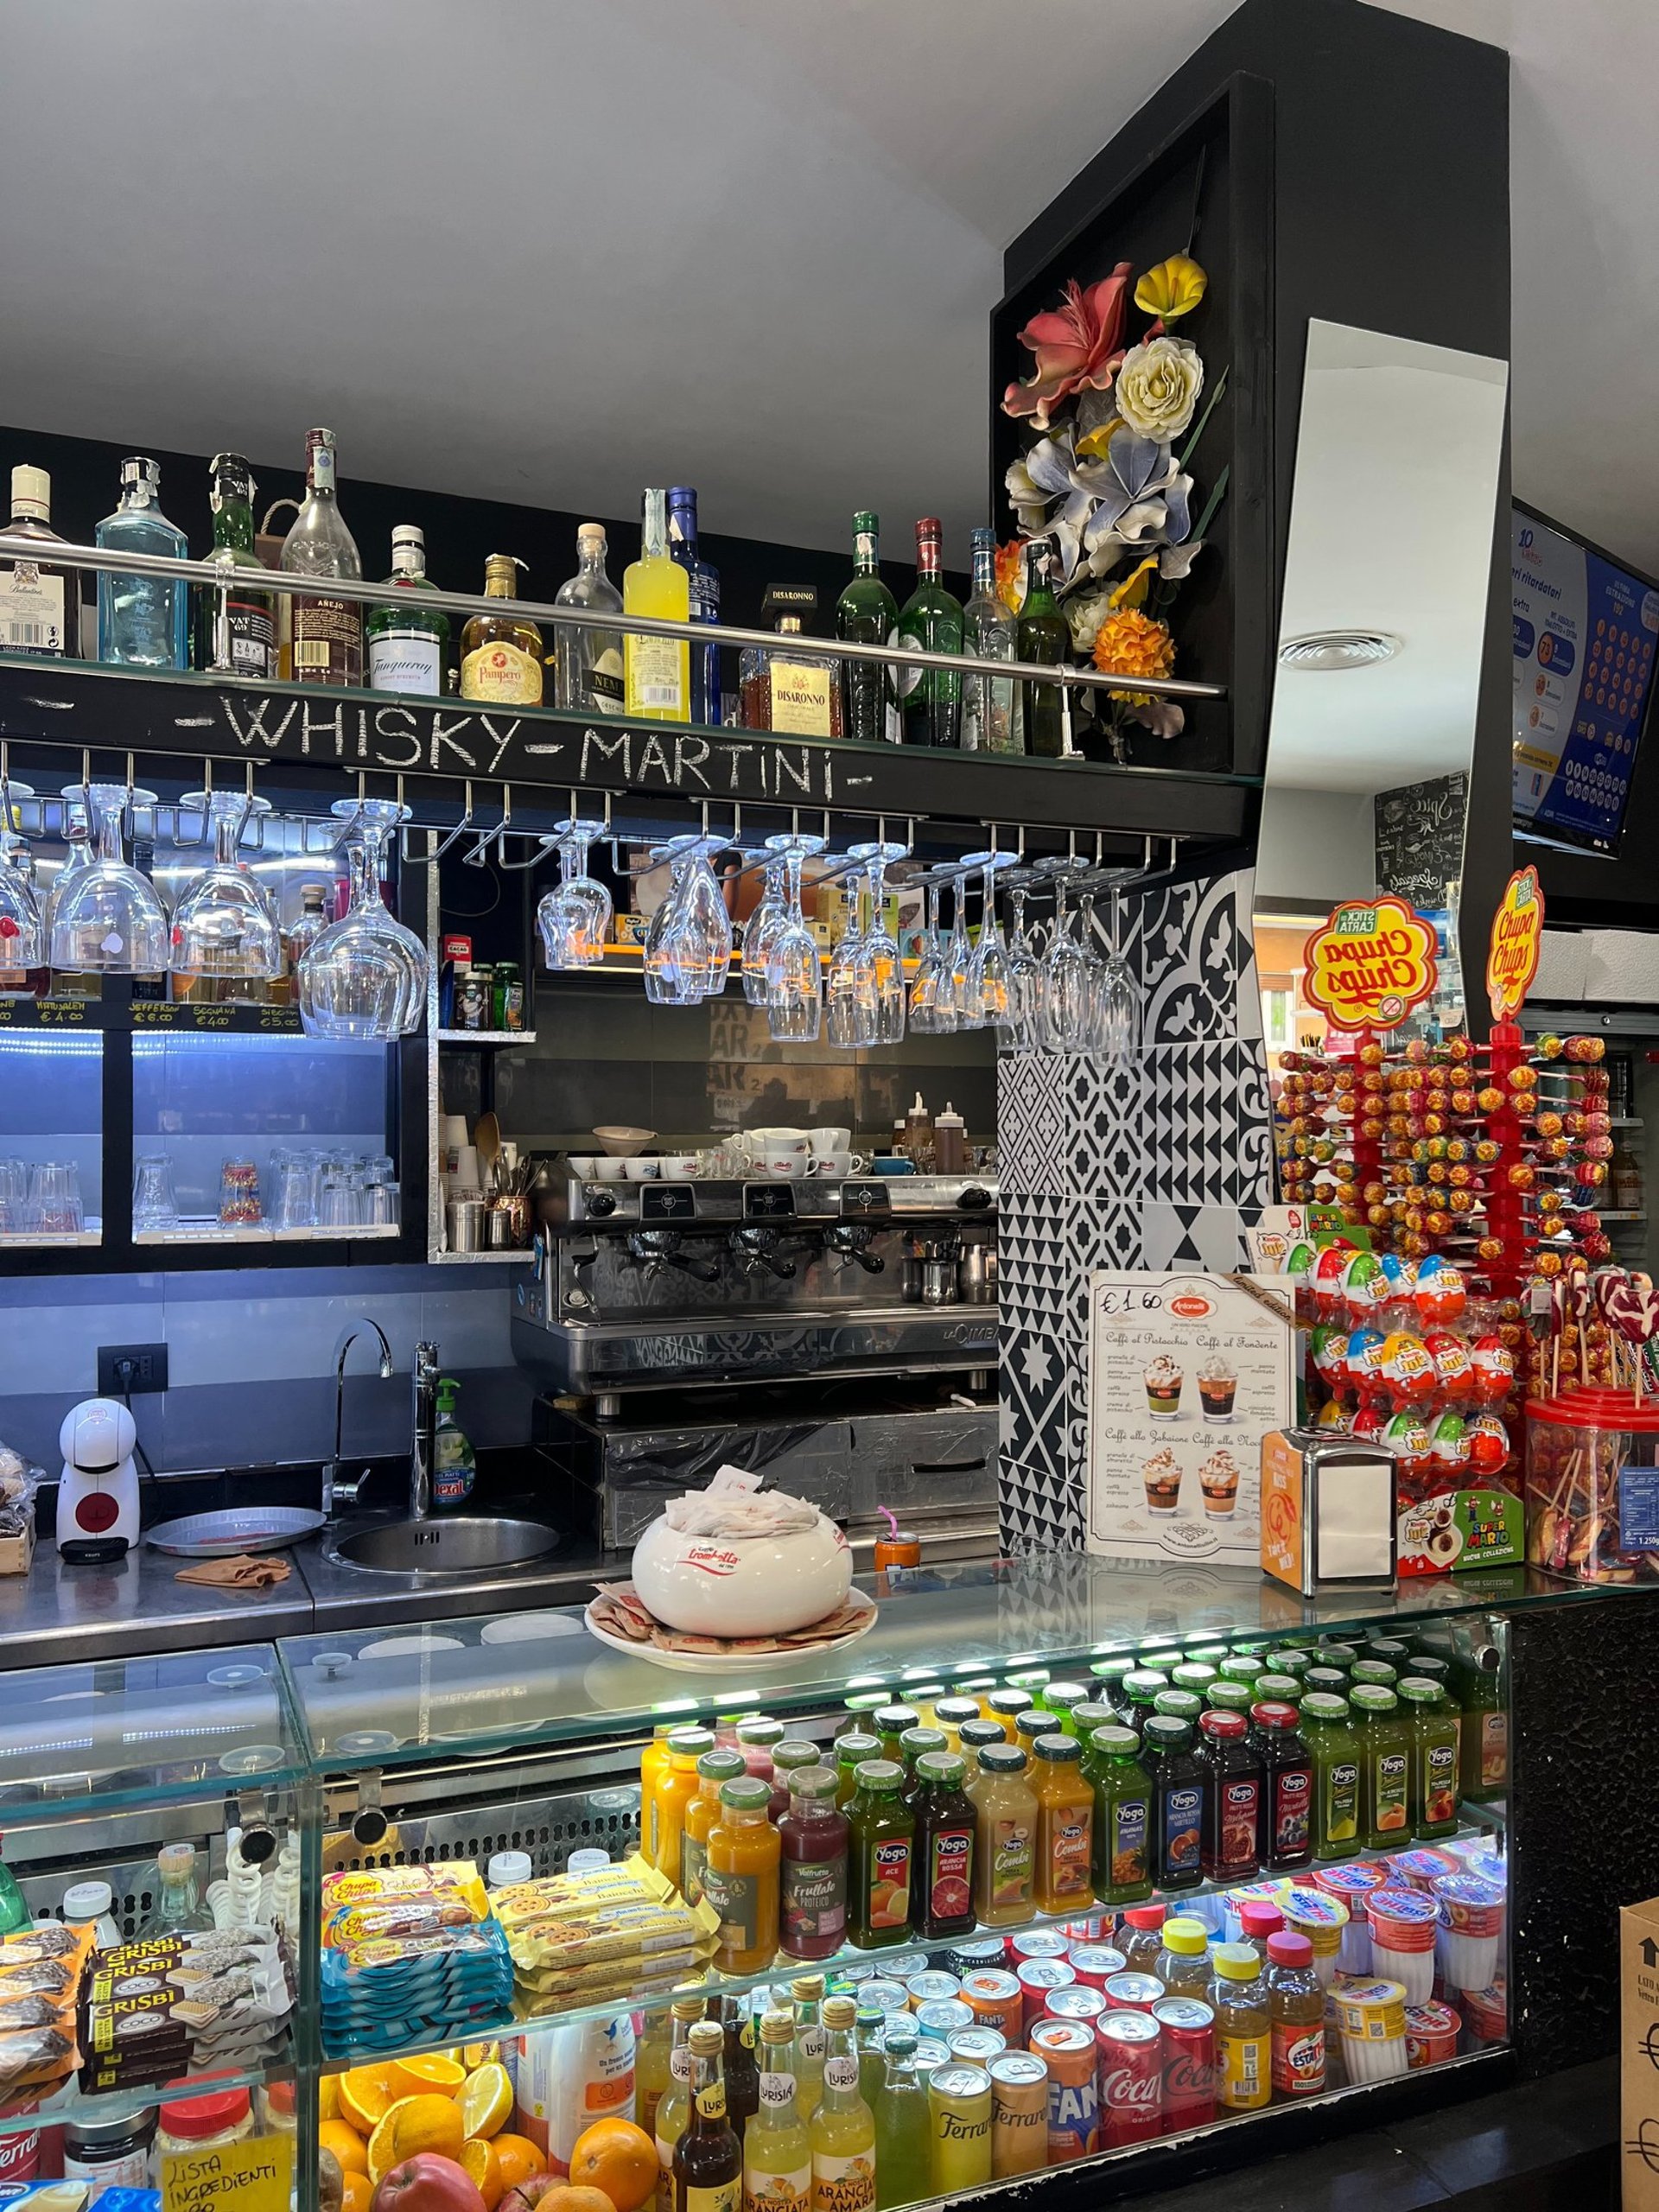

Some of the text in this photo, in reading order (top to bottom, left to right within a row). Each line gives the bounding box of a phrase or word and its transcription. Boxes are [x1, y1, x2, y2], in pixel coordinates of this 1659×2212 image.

[772, 591, 814, 601] DISARONNO
[317, 599, 345, 610] AÑEJO
[228, 616, 251, 626] VAT
[374, 658, 433, 675] Tanqueray
[480, 666, 521, 684] Pampero
[777, 690, 825, 707] DISARONNO
[1498, 910, 1535, 947] Chupa
[1493, 943, 1529, 976] Chups
[1309, 1219, 1344, 1232] MARIO
[1100, 1290, 1162, 1314] € 1.60
[1232, 1276, 1292, 1322] limited edition
[1106, 1332, 1189, 1347] Caffè al Pistacchio
[1196, 1335, 1278, 1351] Caffè al Fondente
[1105, 1427, 1127, 1443] Caffè
[1150, 1430, 1189, 1445] Zabaione
[1192, 1433, 1215, 1448] Caffè
[1472, 1520, 1505, 1534] SUPER
[1466, 1531, 1510, 1549] MARIO
[1431, 1750, 1452, 1764] Yoga
[1382, 1758, 1404, 1772] Yoga
[1284, 1777, 1305, 1789] Yoga
[1333, 1768, 1357, 1783] Yoga
[1173, 1794, 1197, 1808] Yoga
[1231, 1788, 1252, 1800] Yoga
[1116, 1807, 1144, 1822] Yoga
[1062, 1827, 1082, 1837] Yoga
[1120, 1825, 1143, 1835] ANANAS
[940, 1838, 968, 1853] Yoga
[1004, 1840, 1022, 1850] Yoga
[879, 1847, 906, 1863] Yoga
[939, 1857, 966, 1866] ARANCIA
[942, 1863, 963, 1872] ROSSA
[337, 1879, 378, 1894] Chupa
[793, 1880, 836, 1897] Frullato
[800, 1896, 830, 1908] PROTEICO
[979, 2014, 1006, 2025] FANTA
